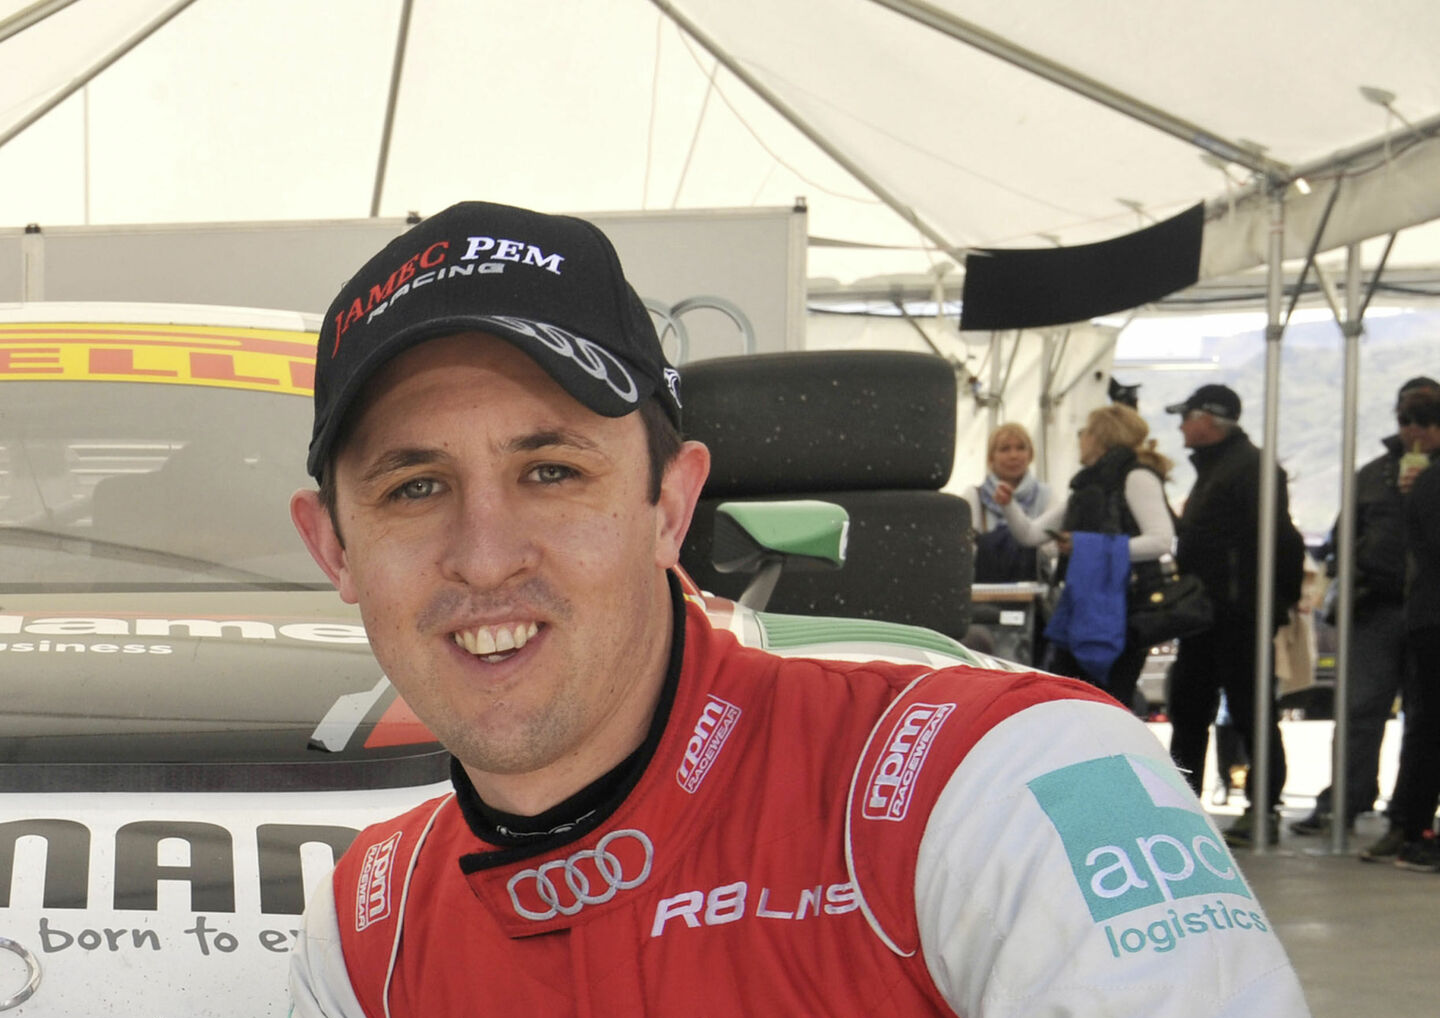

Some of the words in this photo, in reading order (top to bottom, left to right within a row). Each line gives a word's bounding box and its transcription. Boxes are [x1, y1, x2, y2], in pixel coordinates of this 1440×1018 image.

[331, 241, 449, 359] JAMEC
[460, 236, 565, 275] PEM
[367, 262, 505, 324] RACING
[679, 701, 724, 778] rpm
[688, 709, 737, 790] RACEWEAR
[869, 710, 934, 808] rpm
[892, 706, 949, 816] RACEWEAR
[370, 839, 395, 918] rpm
[1085, 834, 1236, 901] apc
[39, 917, 161, 953] born
[184, 916, 239, 956] to
[651, 881, 747, 938] R8
[1105, 900, 1268, 957] logistics
